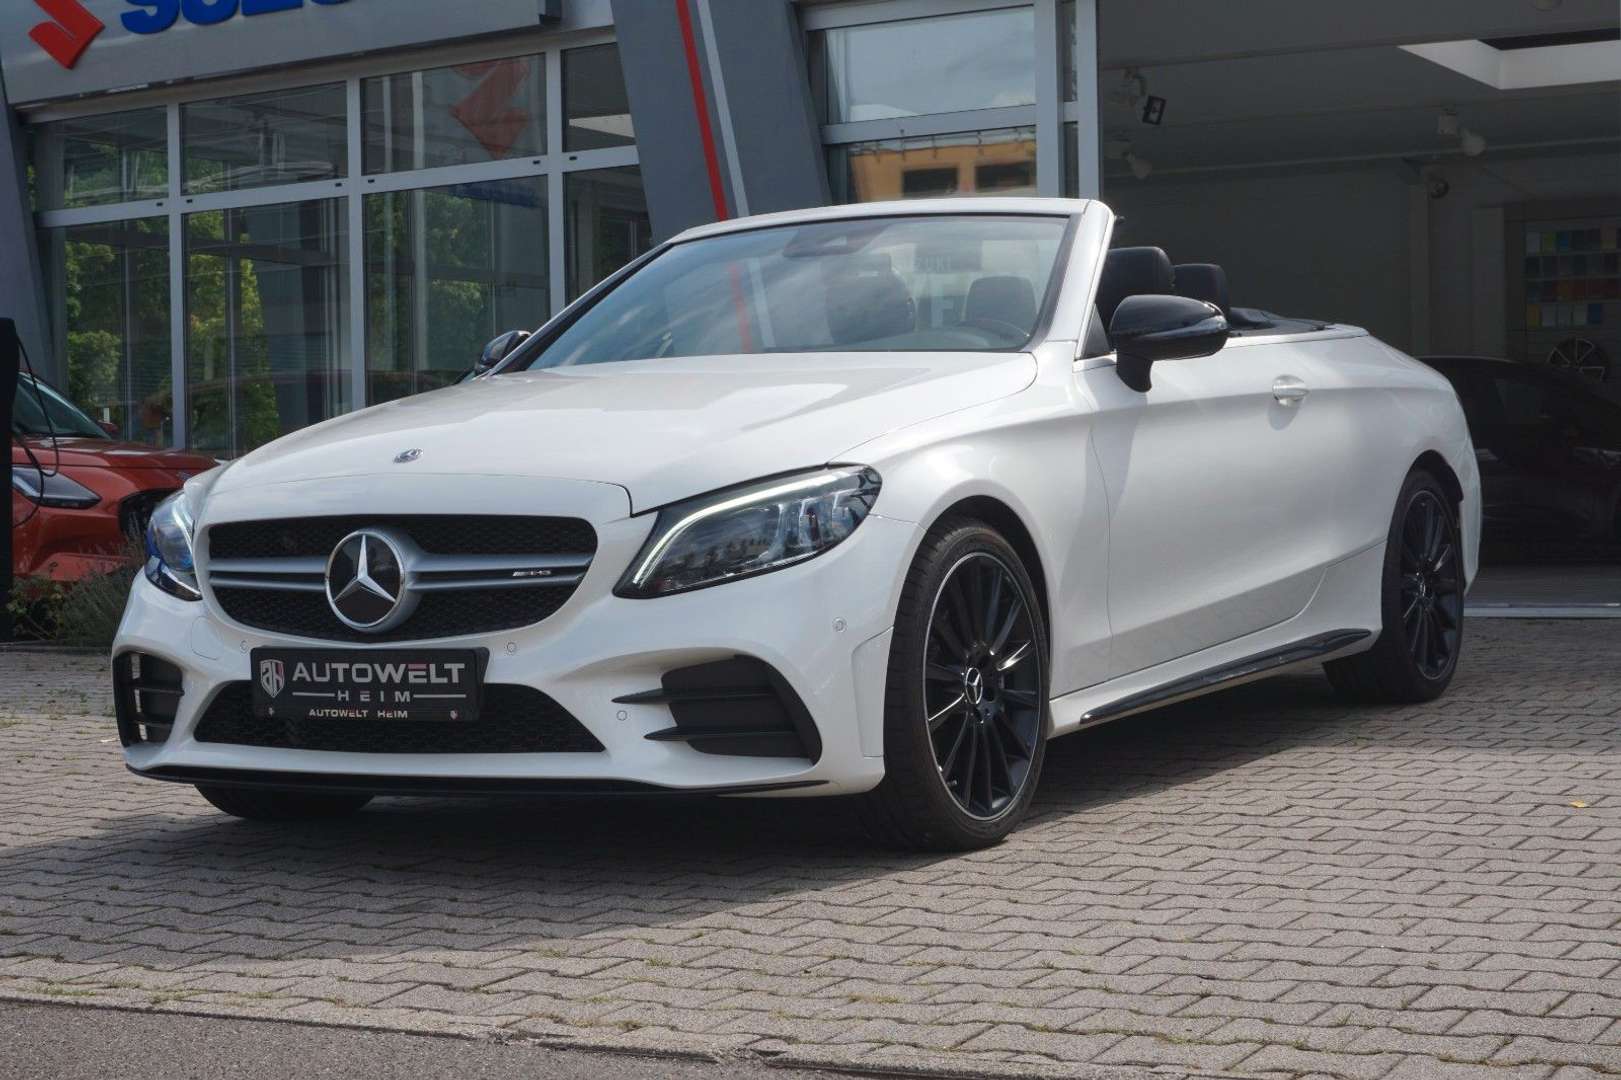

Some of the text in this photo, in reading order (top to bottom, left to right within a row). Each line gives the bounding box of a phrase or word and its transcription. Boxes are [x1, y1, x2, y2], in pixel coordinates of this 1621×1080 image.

[293, 663, 465, 683] AUTOWELT
[337, 690, 411, 703] HEIM
[308, 709, 408, 719] AUTOWELT HEIM
